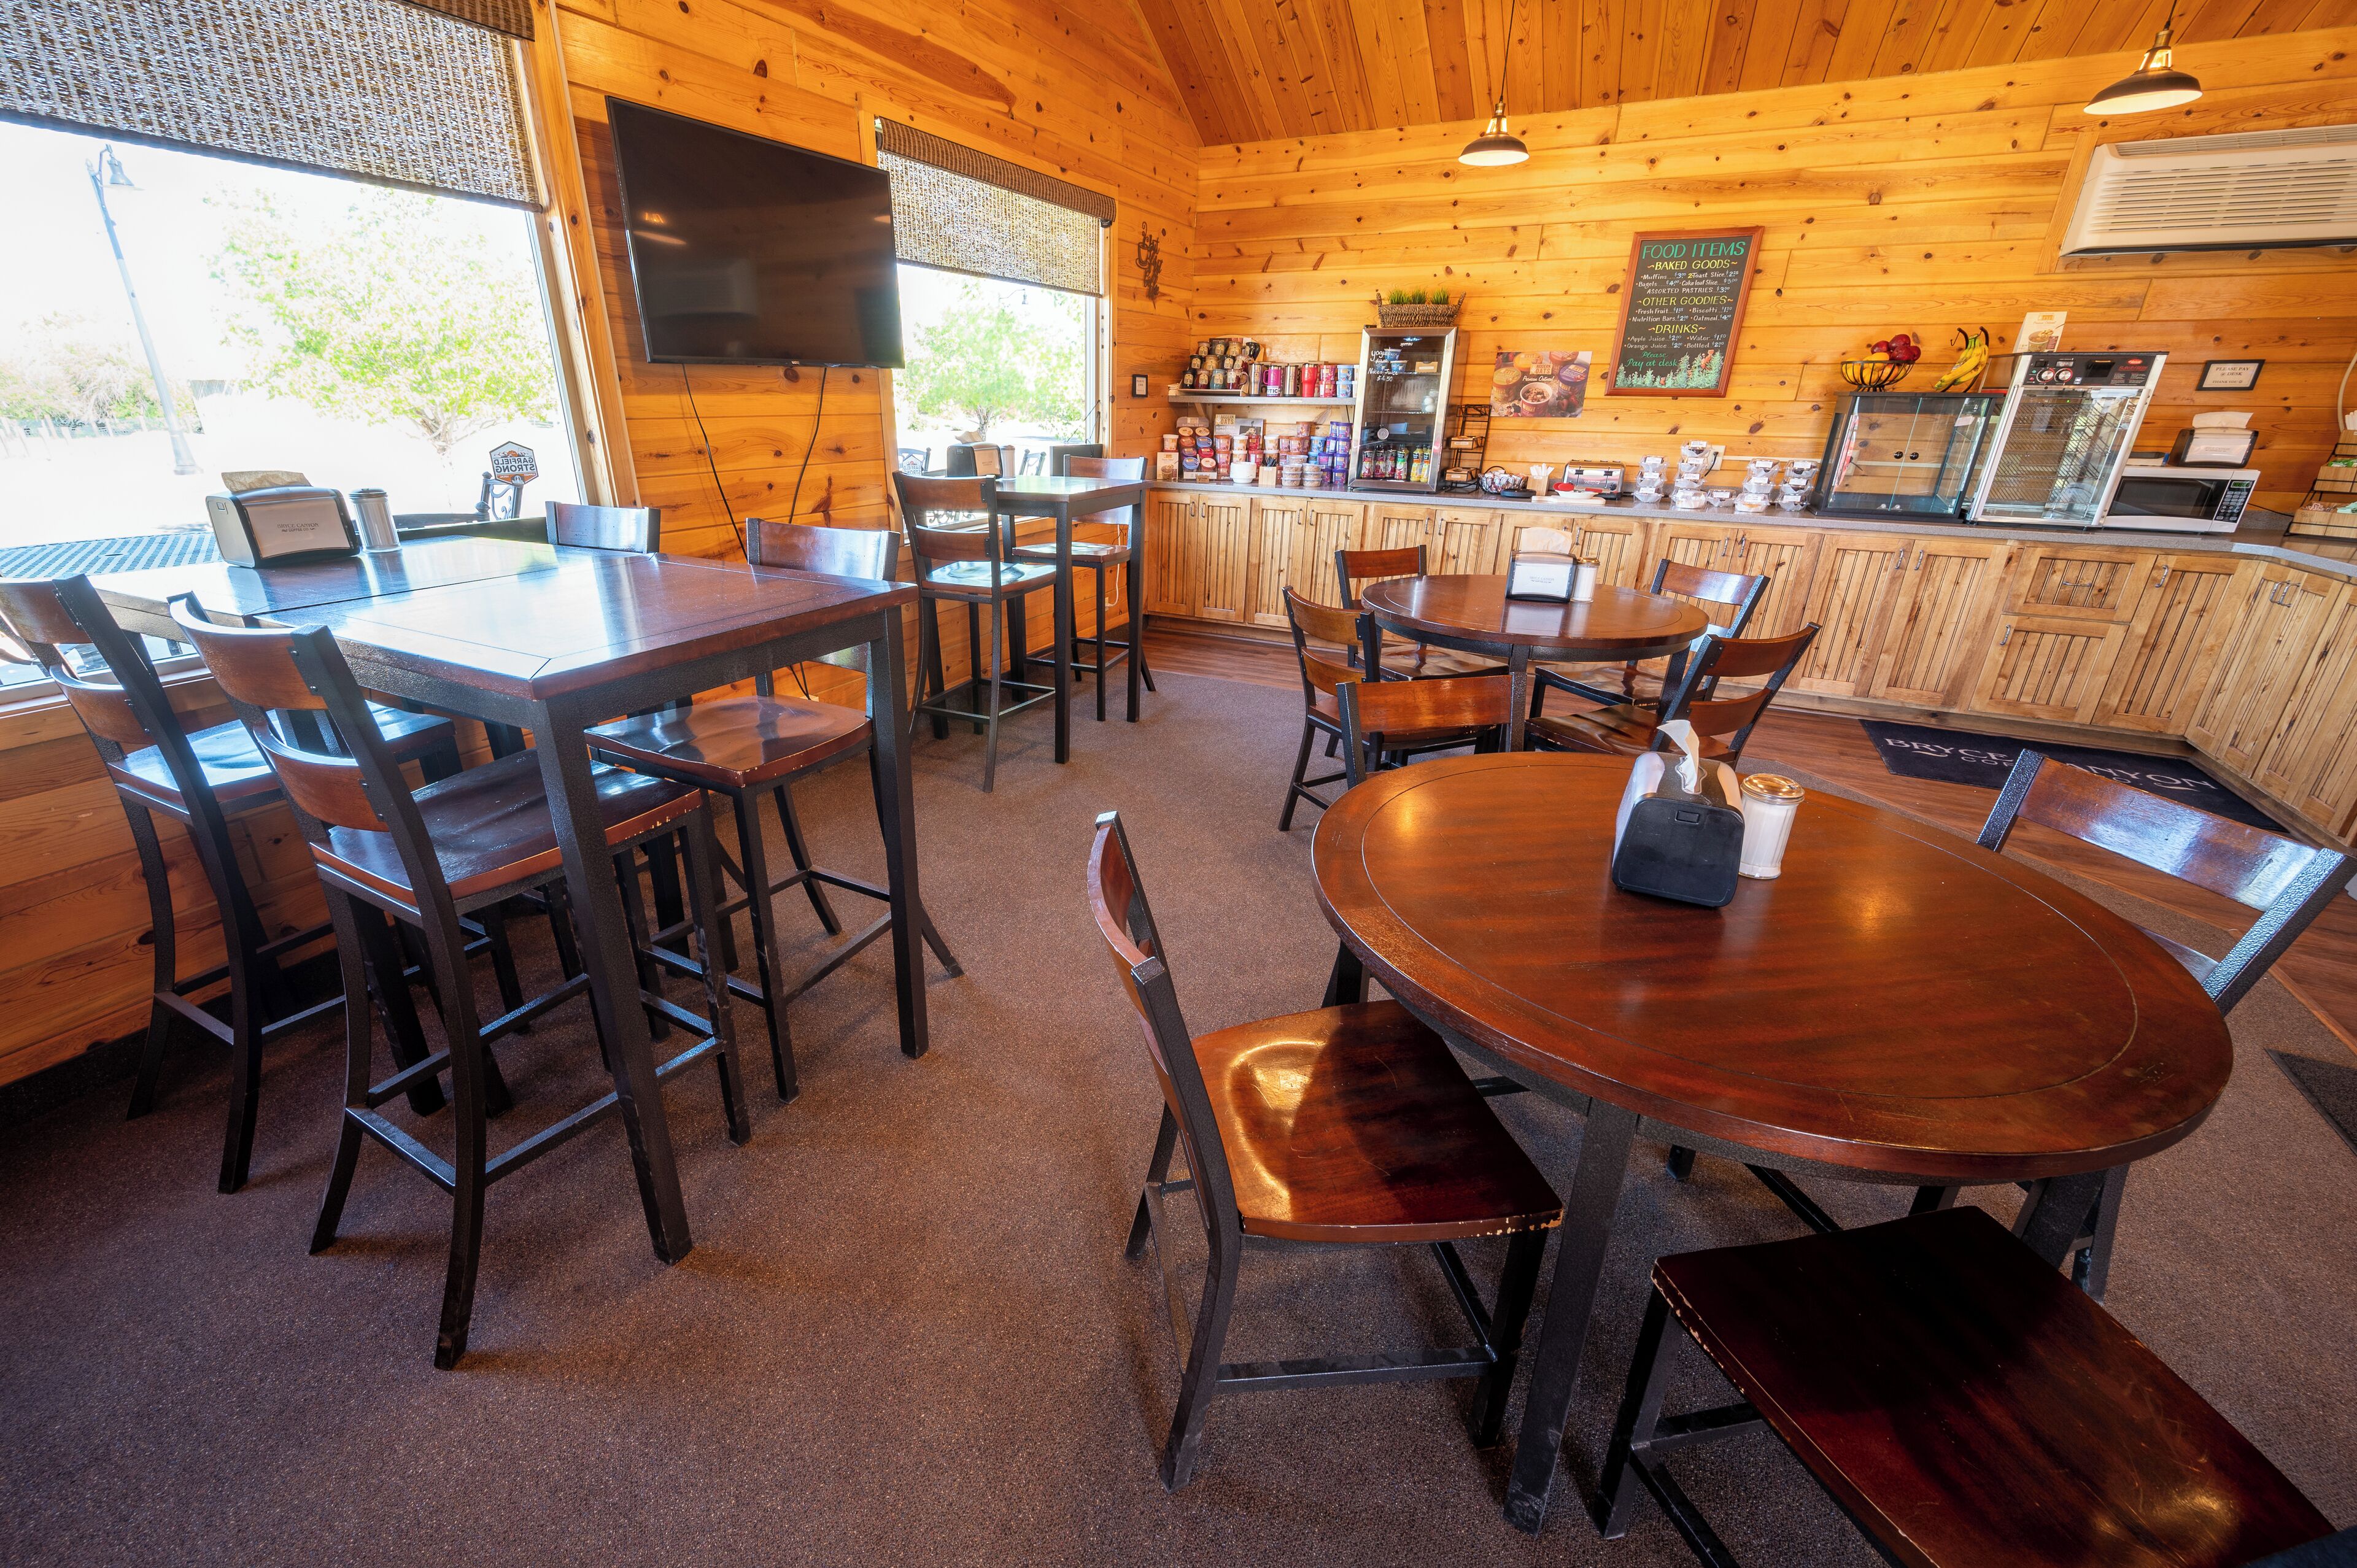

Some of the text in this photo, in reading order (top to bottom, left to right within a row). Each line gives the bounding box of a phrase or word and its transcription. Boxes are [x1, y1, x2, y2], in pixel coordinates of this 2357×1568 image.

[1642, 241, 1746, 259] FOOD ITEMS
[1655, 259, 1730, 271] BAKED GOODS
[1643, 295, 1727, 306] OTHER GOODIES
[1655, 323, 1698, 334] DRINKS
[1625, 358, 1644, 371] Pay
[1884, 738, 2014, 762] BRYCE
